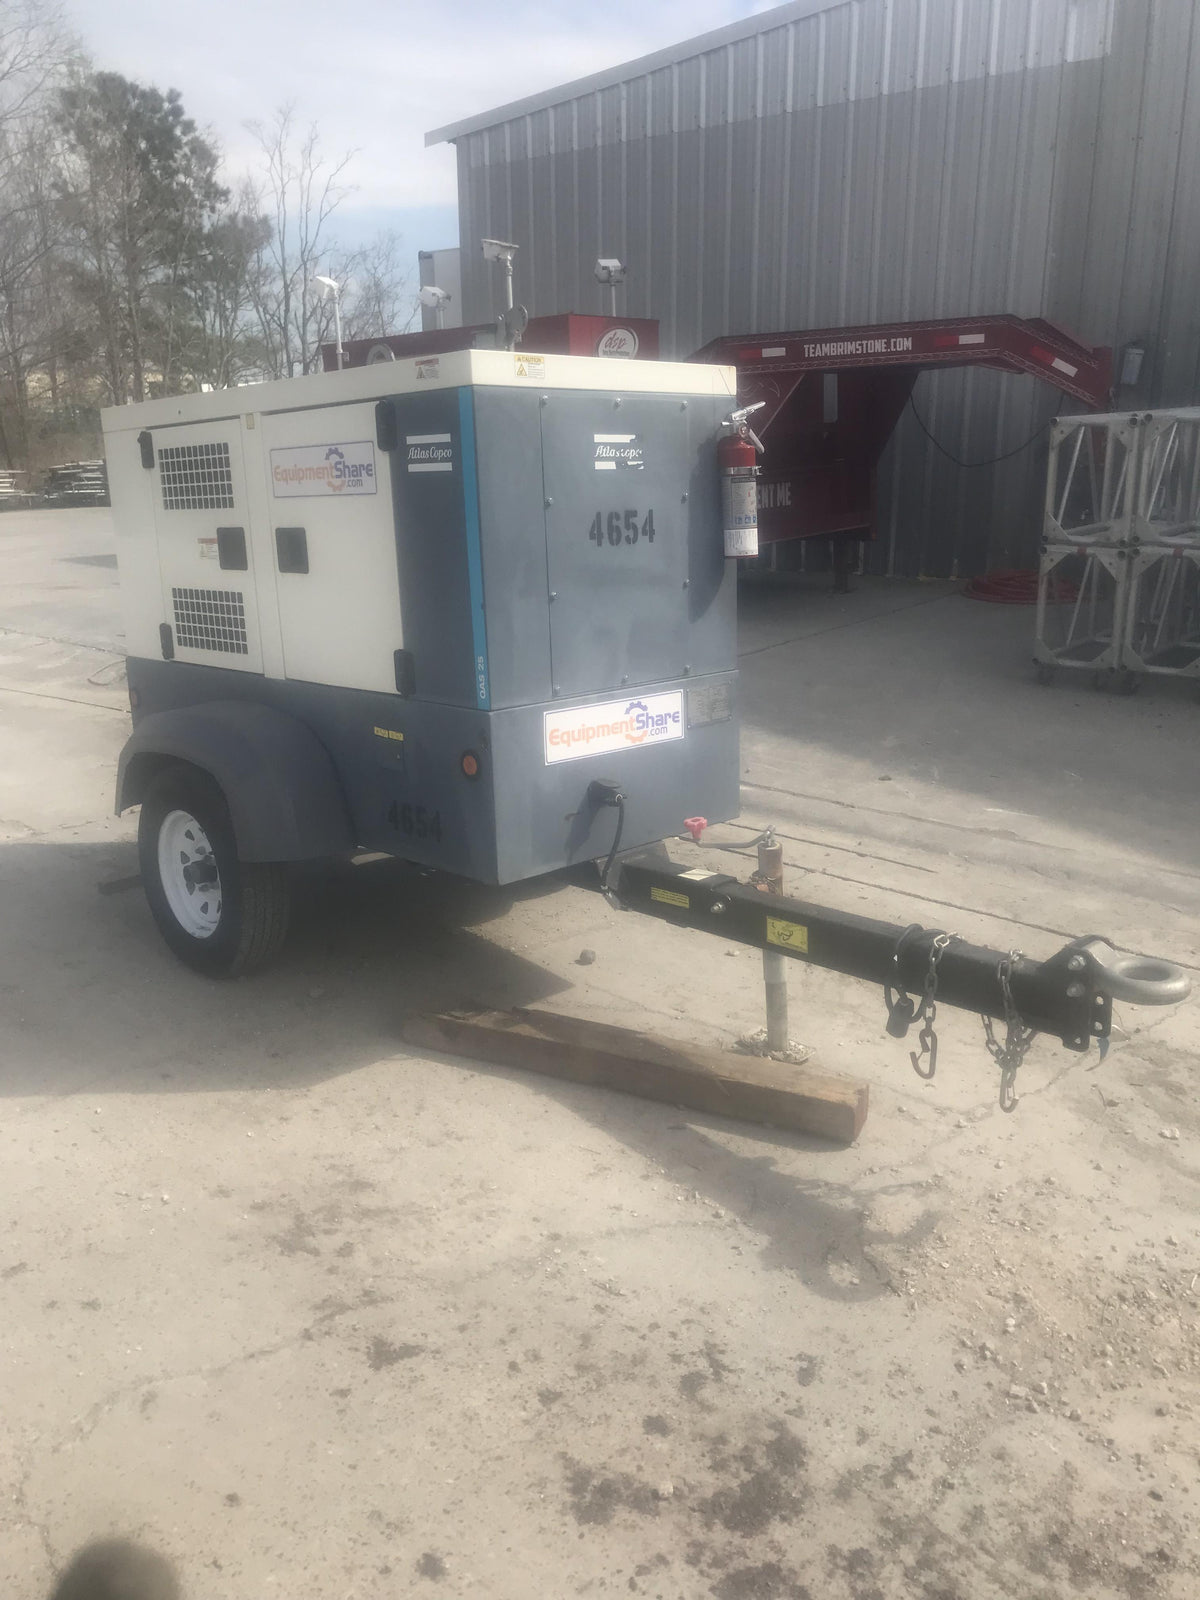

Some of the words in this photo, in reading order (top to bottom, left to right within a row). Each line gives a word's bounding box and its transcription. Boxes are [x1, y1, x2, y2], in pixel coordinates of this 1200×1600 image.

[803, 336, 912, 358] TEAMBRIMSTONE.COM
[407, 446, 430, 460] Atlas
[430, 446, 452, 461] Copco
[594, 445, 620, 458] Atlas
[273, 460, 374, 485] EquipmentShare
[346, 478, 364, 488] .com
[757, 485, 774, 509] ENT
[776, 482, 792, 507] ME
[588, 508, 656, 547] 4654
[477, 655, 485, 671] 25
[548, 710, 681, 748] EquipmentShare
[648, 726, 668, 738] .com
[387, 799, 442, 844] 4654
